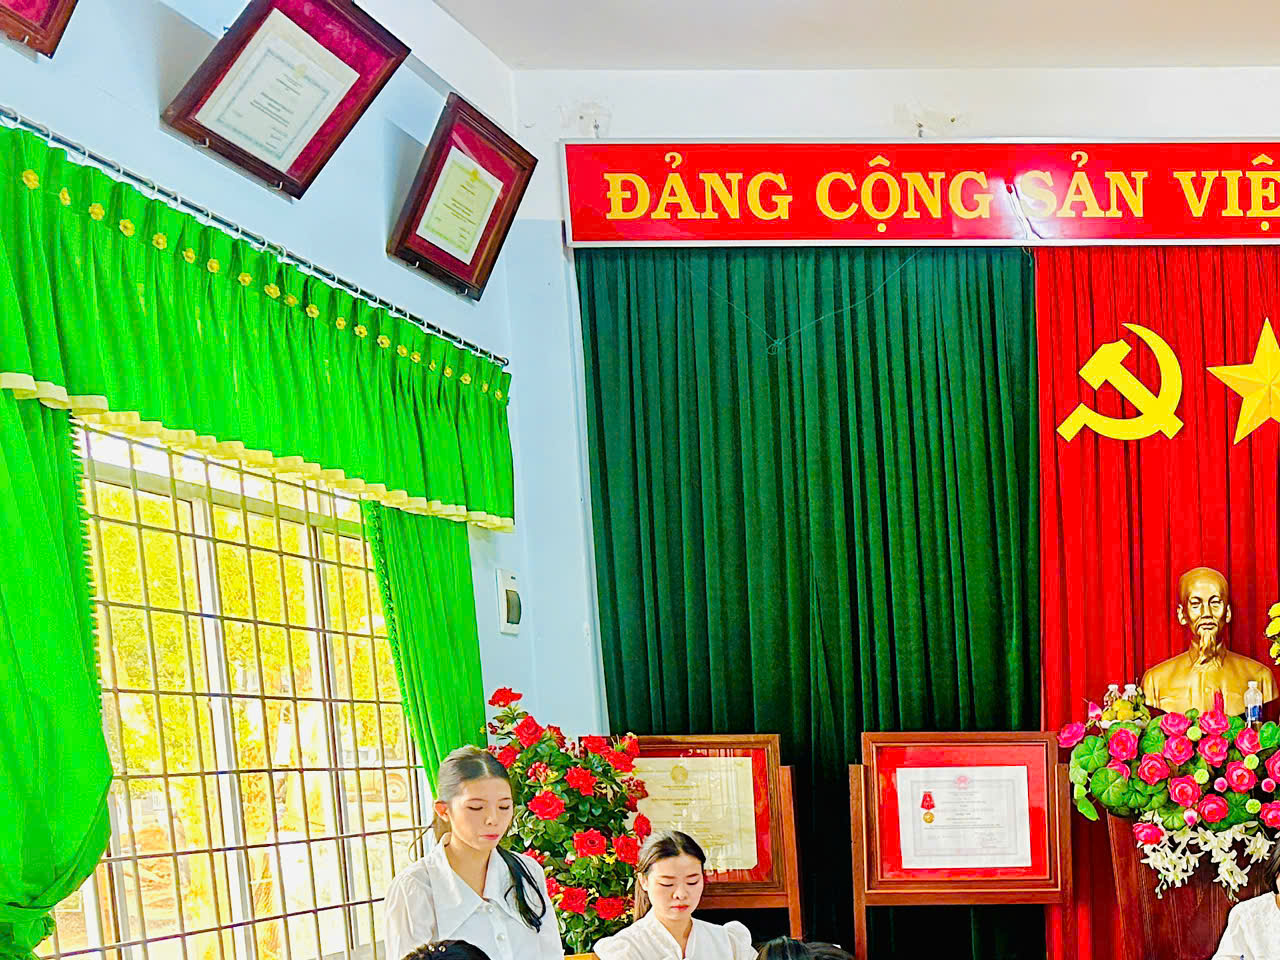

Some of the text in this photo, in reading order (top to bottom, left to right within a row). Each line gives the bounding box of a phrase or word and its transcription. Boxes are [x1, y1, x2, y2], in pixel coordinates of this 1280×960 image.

[604, 152, 792, 221] ĐẢNG
[816, 155, 994, 233] CỘNG
[1020, 151, 1148, 219] SẢN
